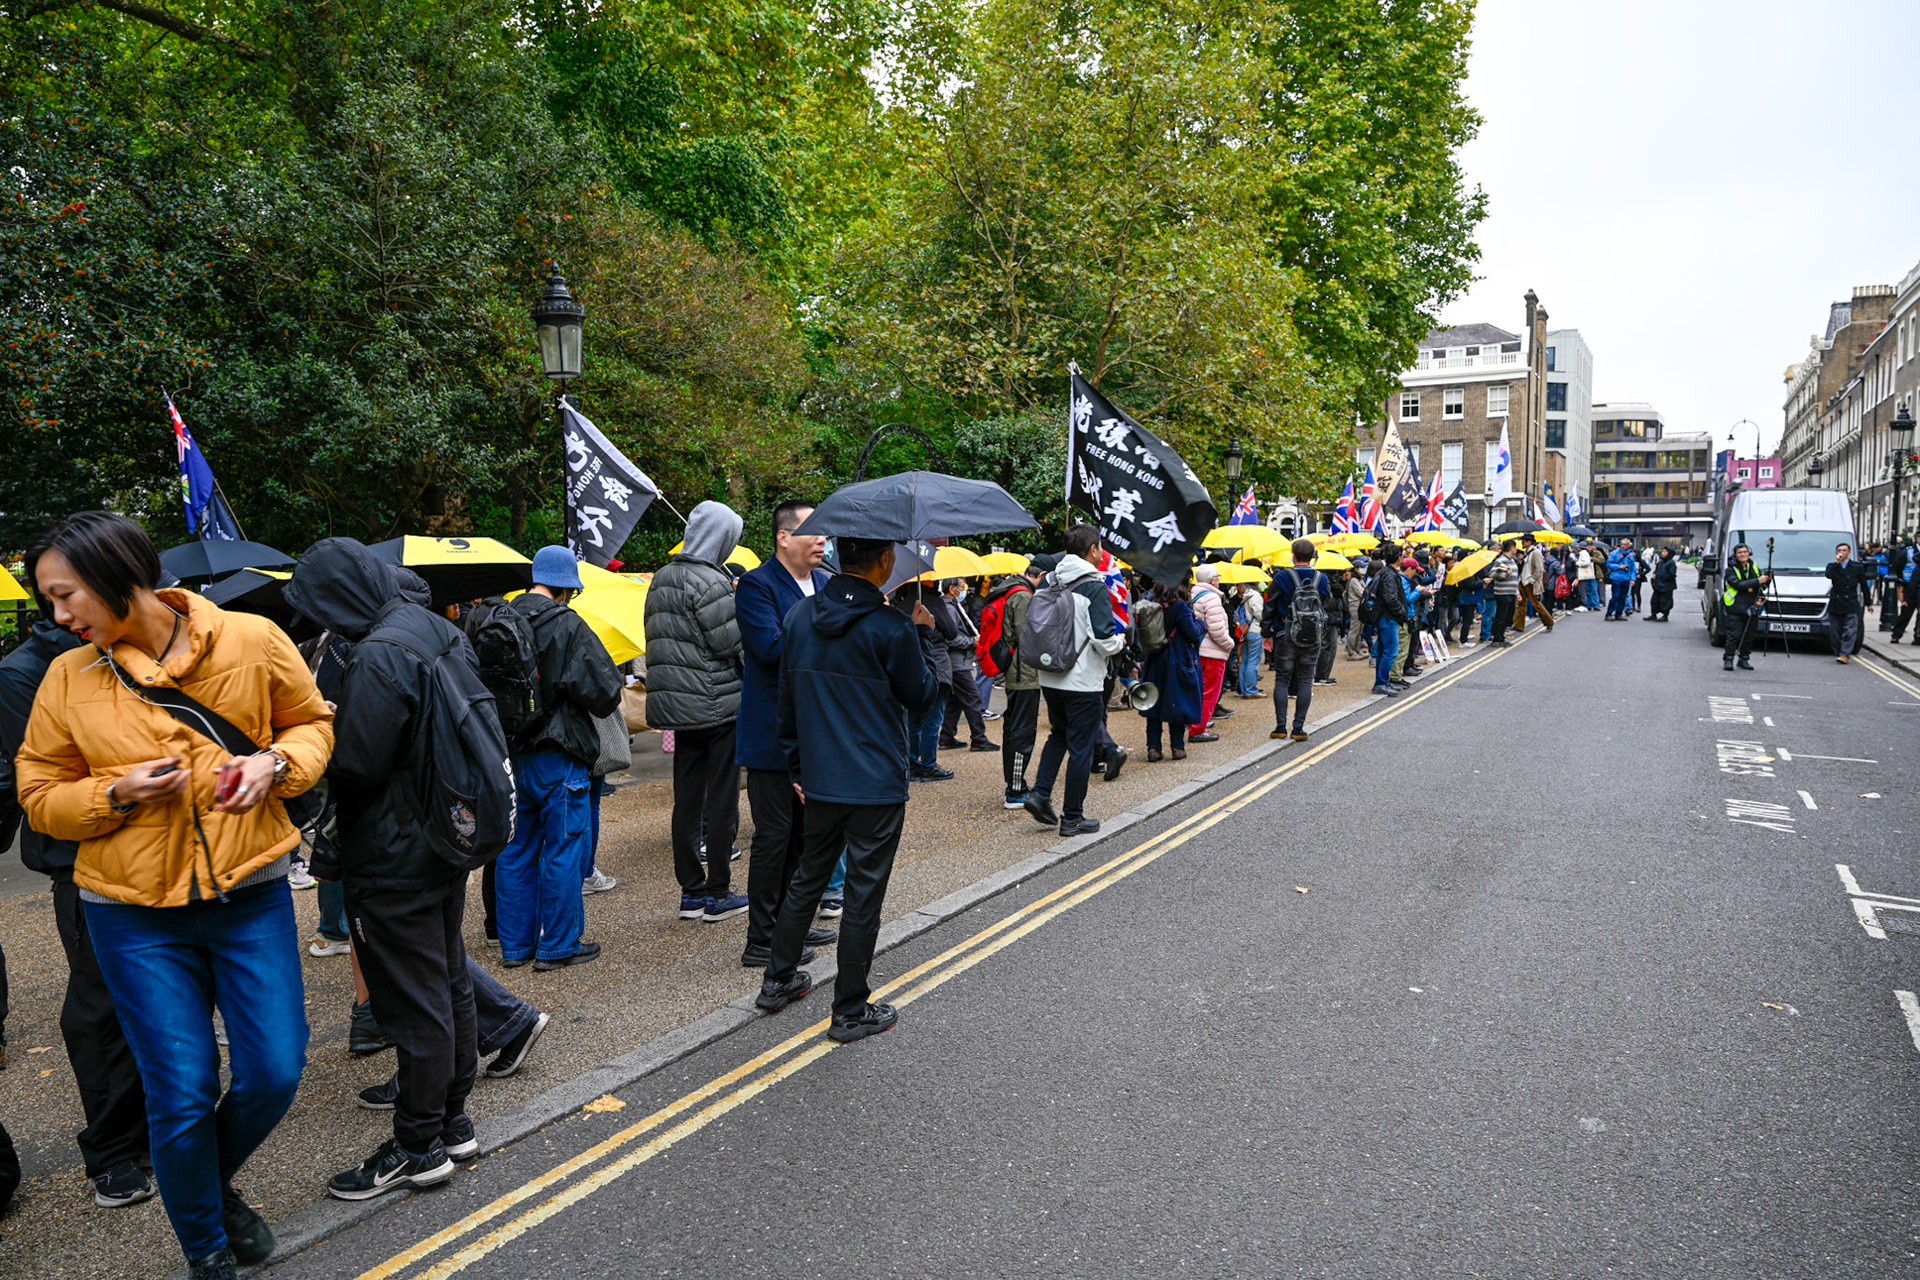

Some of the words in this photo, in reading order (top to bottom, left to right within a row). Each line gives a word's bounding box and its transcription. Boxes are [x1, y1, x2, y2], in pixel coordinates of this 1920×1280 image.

[1085, 442, 1108, 460] FREE
[1107, 454, 1135, 475] HONG
[1135, 469, 1165, 490] KONG
[1108, 531, 1131, 550] NOW
[1724, 798, 1796, 833] ONLY
